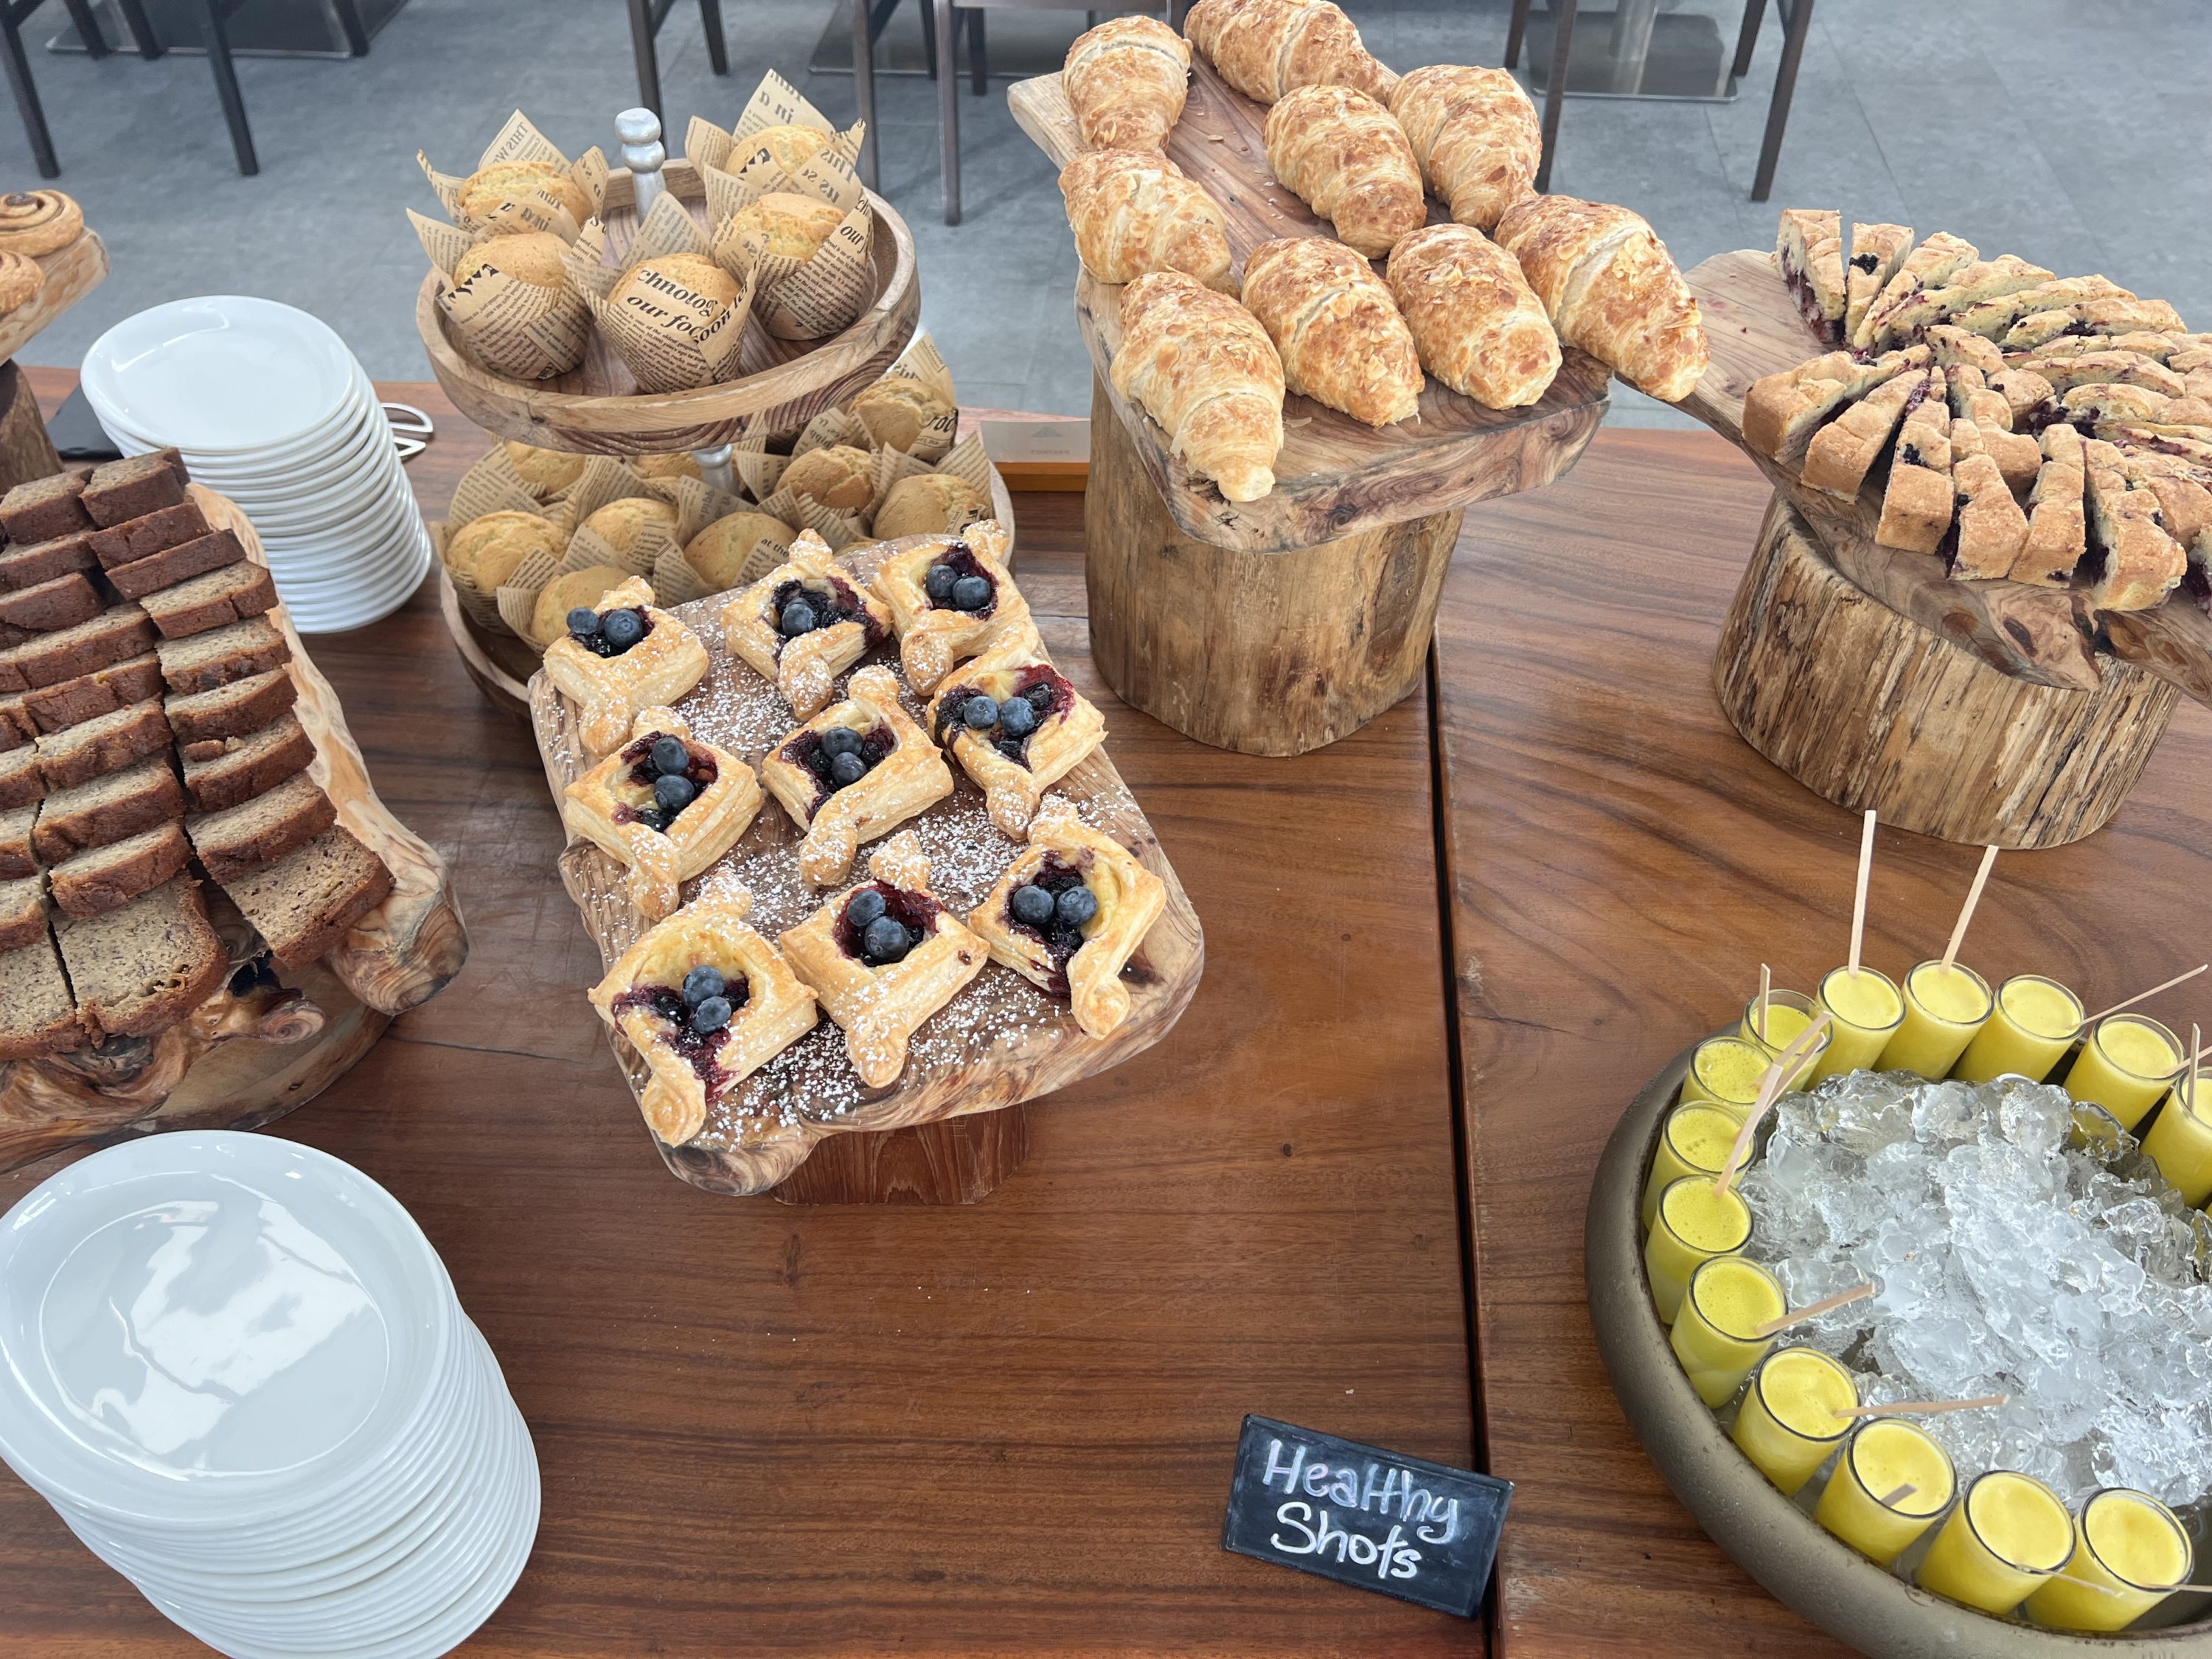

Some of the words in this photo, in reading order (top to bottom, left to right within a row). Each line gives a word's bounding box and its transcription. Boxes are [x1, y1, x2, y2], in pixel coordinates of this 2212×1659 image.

[627, 296, 668, 318] our
[1262, 1439, 1458, 1544] Healthy
[1270, 1501, 1422, 1579] Shots
